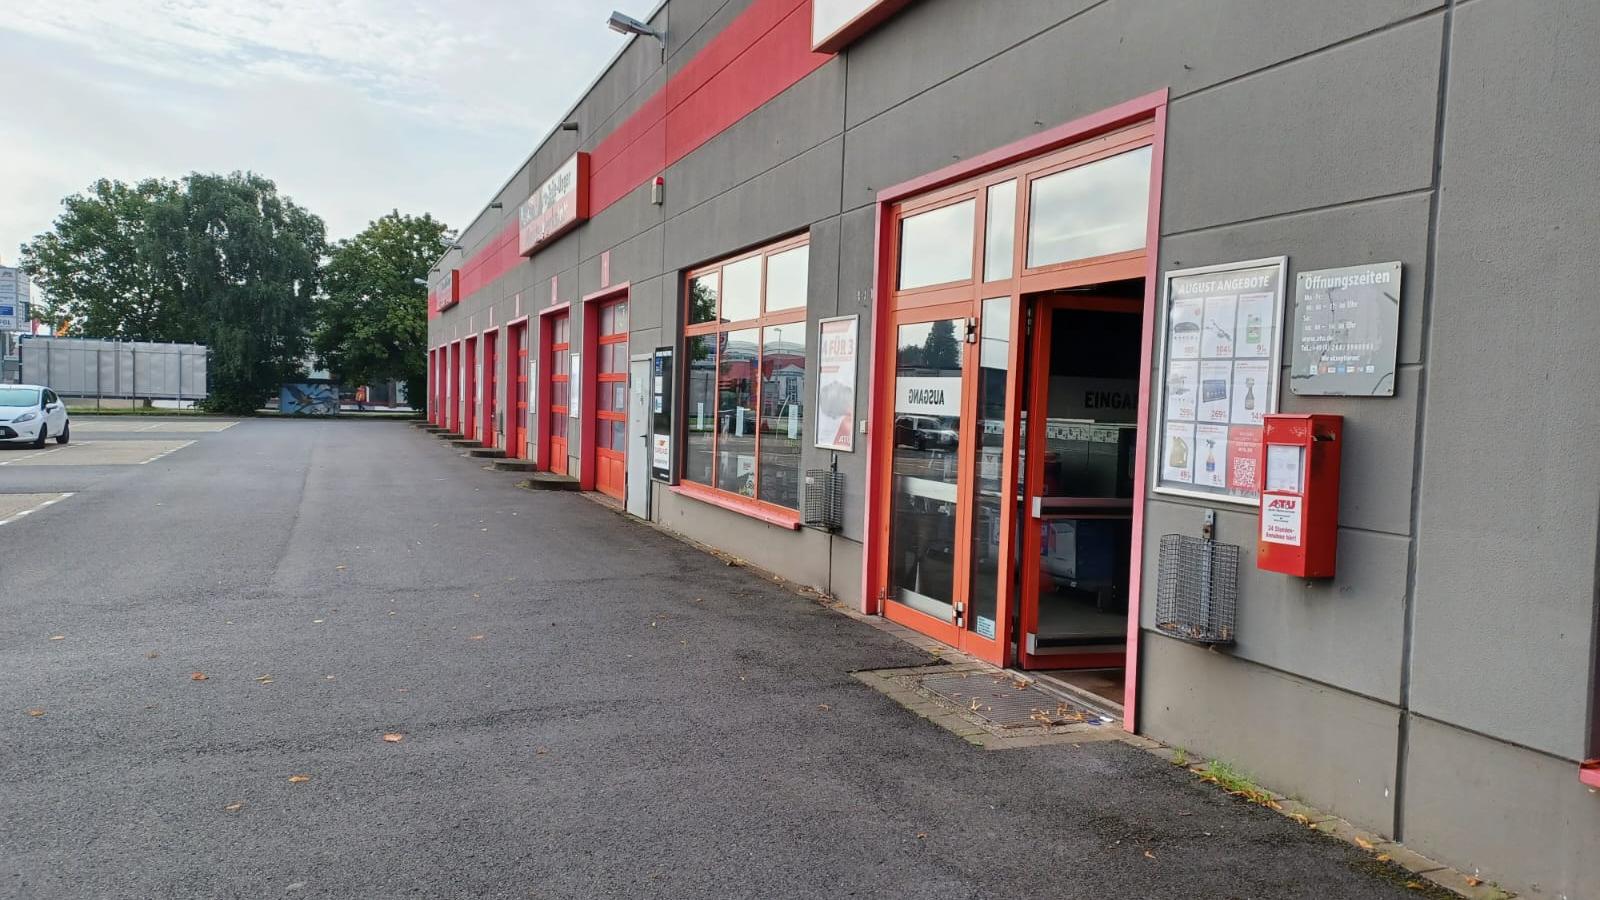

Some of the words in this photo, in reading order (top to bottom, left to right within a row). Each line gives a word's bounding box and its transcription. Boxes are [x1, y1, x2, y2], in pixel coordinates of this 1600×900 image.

[1178, 280, 1216, 295] AUGUST
[1217, 275, 1270, 292] ANGEBOTE
[1304, 271, 1390, 290] Öffnungszeiten
[848, 338, 855, 355] 3
